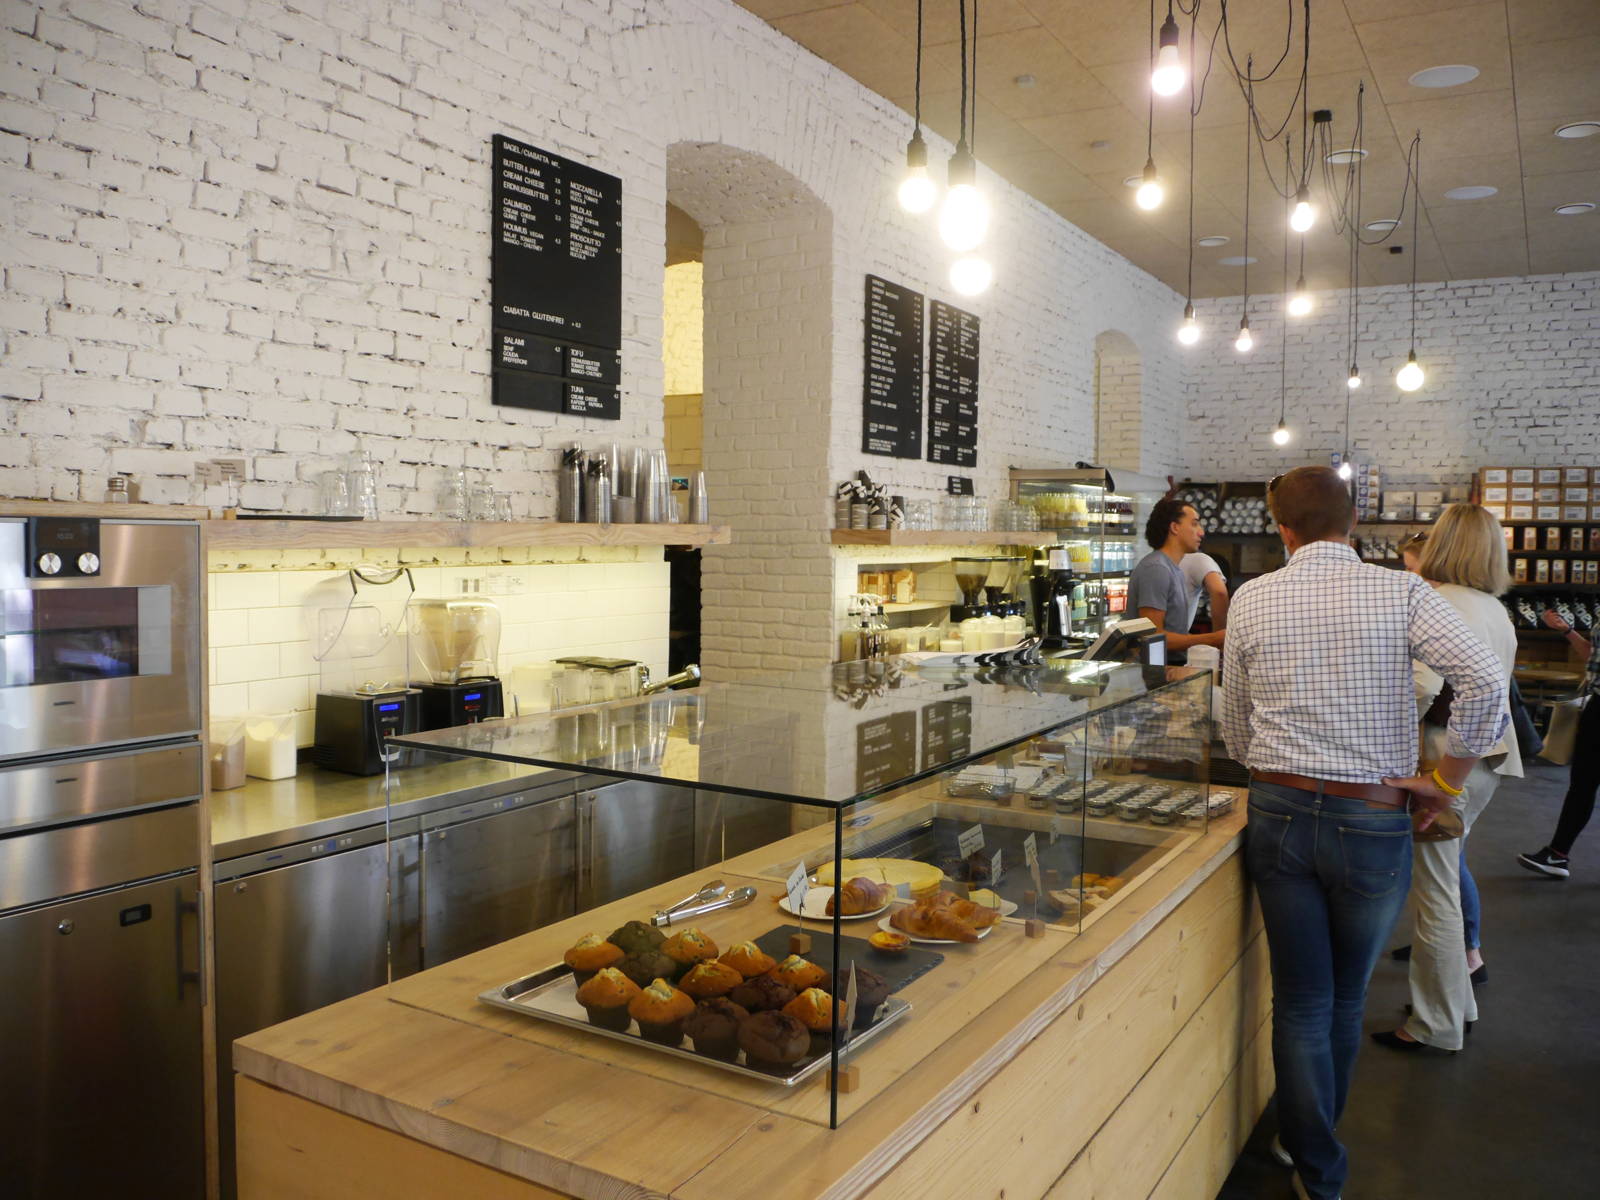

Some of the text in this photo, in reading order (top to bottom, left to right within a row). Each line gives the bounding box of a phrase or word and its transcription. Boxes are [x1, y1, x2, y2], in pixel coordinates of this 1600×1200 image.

[503, 158, 523, 172] BUTTER
[503, 170, 522, 182] CREAM
[570, 181, 603, 199] MOZZARELLA
[503, 305, 530, 318] CIABATTA
[532, 311, 565, 325] GLUTENFREI
[503, 336, 525, 346] SALAMI
[570, 348, 584, 358] TOFU
[570, 385, 584, 394] TUNA
